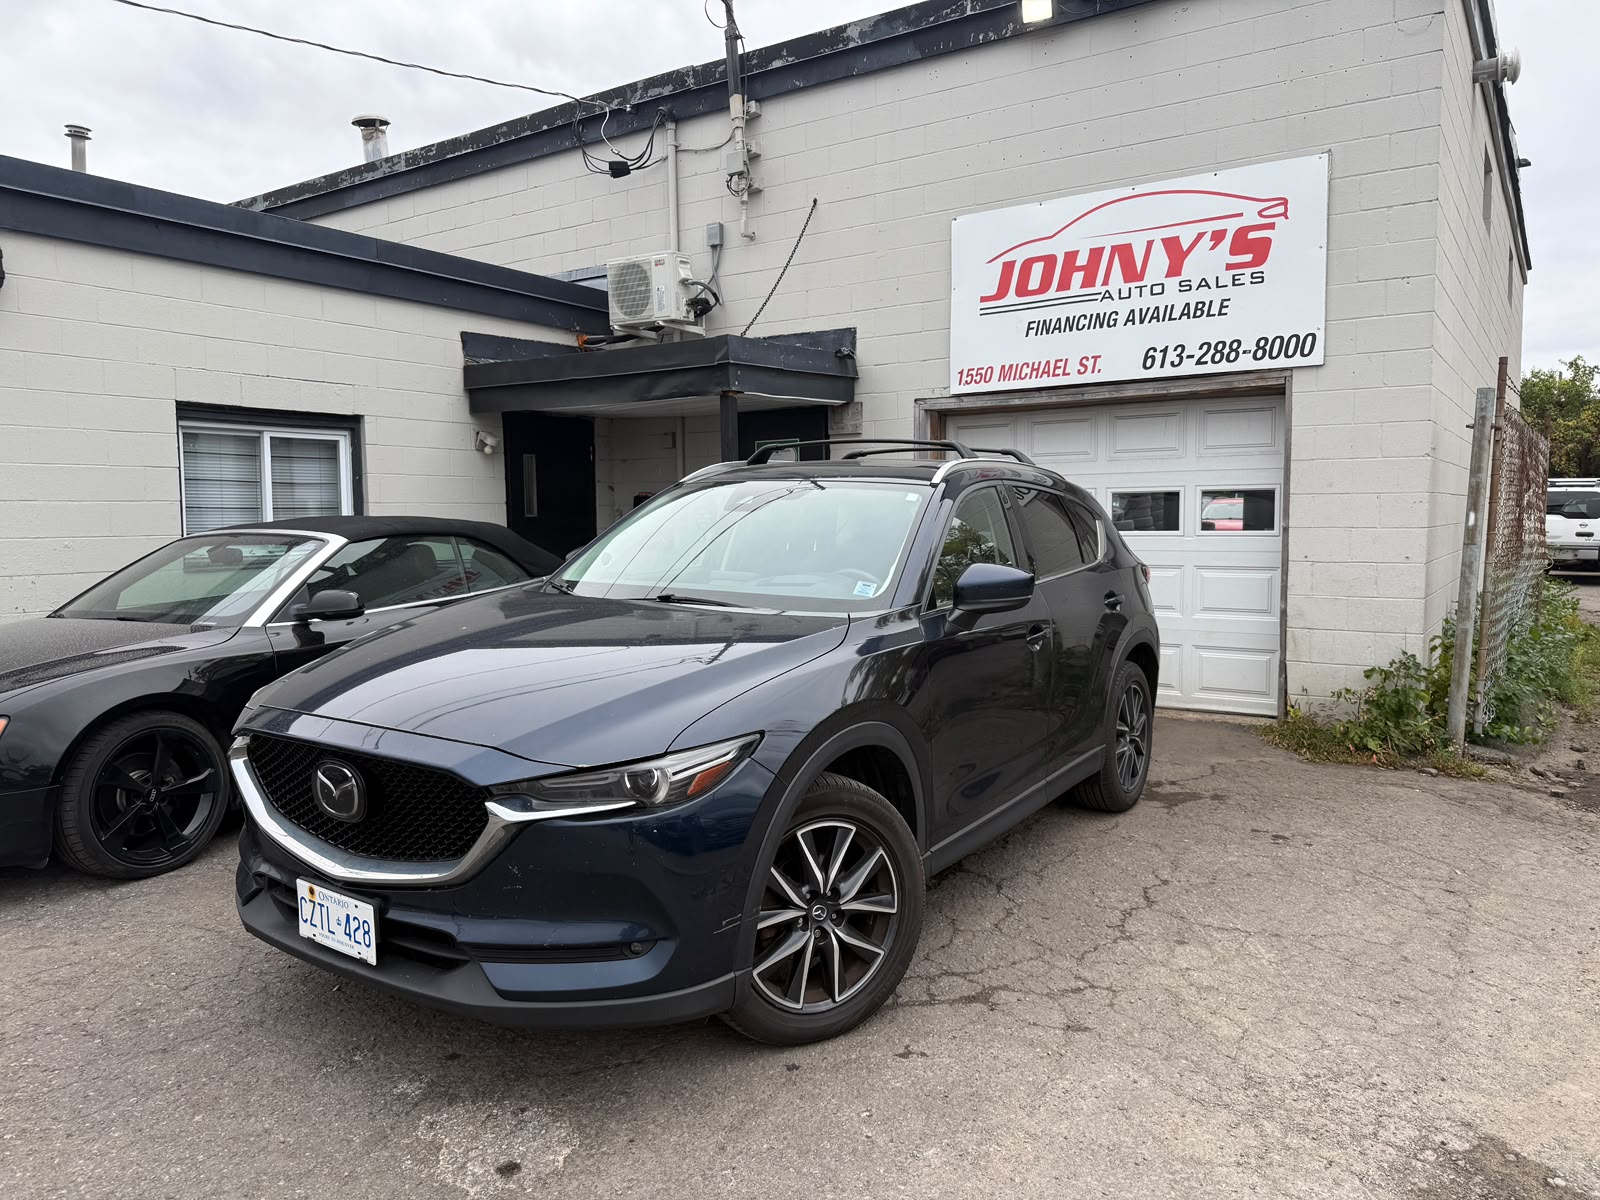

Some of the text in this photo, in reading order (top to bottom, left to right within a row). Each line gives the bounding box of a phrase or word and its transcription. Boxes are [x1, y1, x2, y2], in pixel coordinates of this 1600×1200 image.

[980, 222, 1276, 303] JOHNY'S
[1099, 270, 1265, 303] AUTO SALES
[1025, 298, 1231, 338] FINANCING AVAILABLE
[957, 354, 1103, 387] 1550 MICHAEL ST.
[1142, 332, 1317, 371] 613-288-8000
[299, 895, 372, 949] CZTL 428
